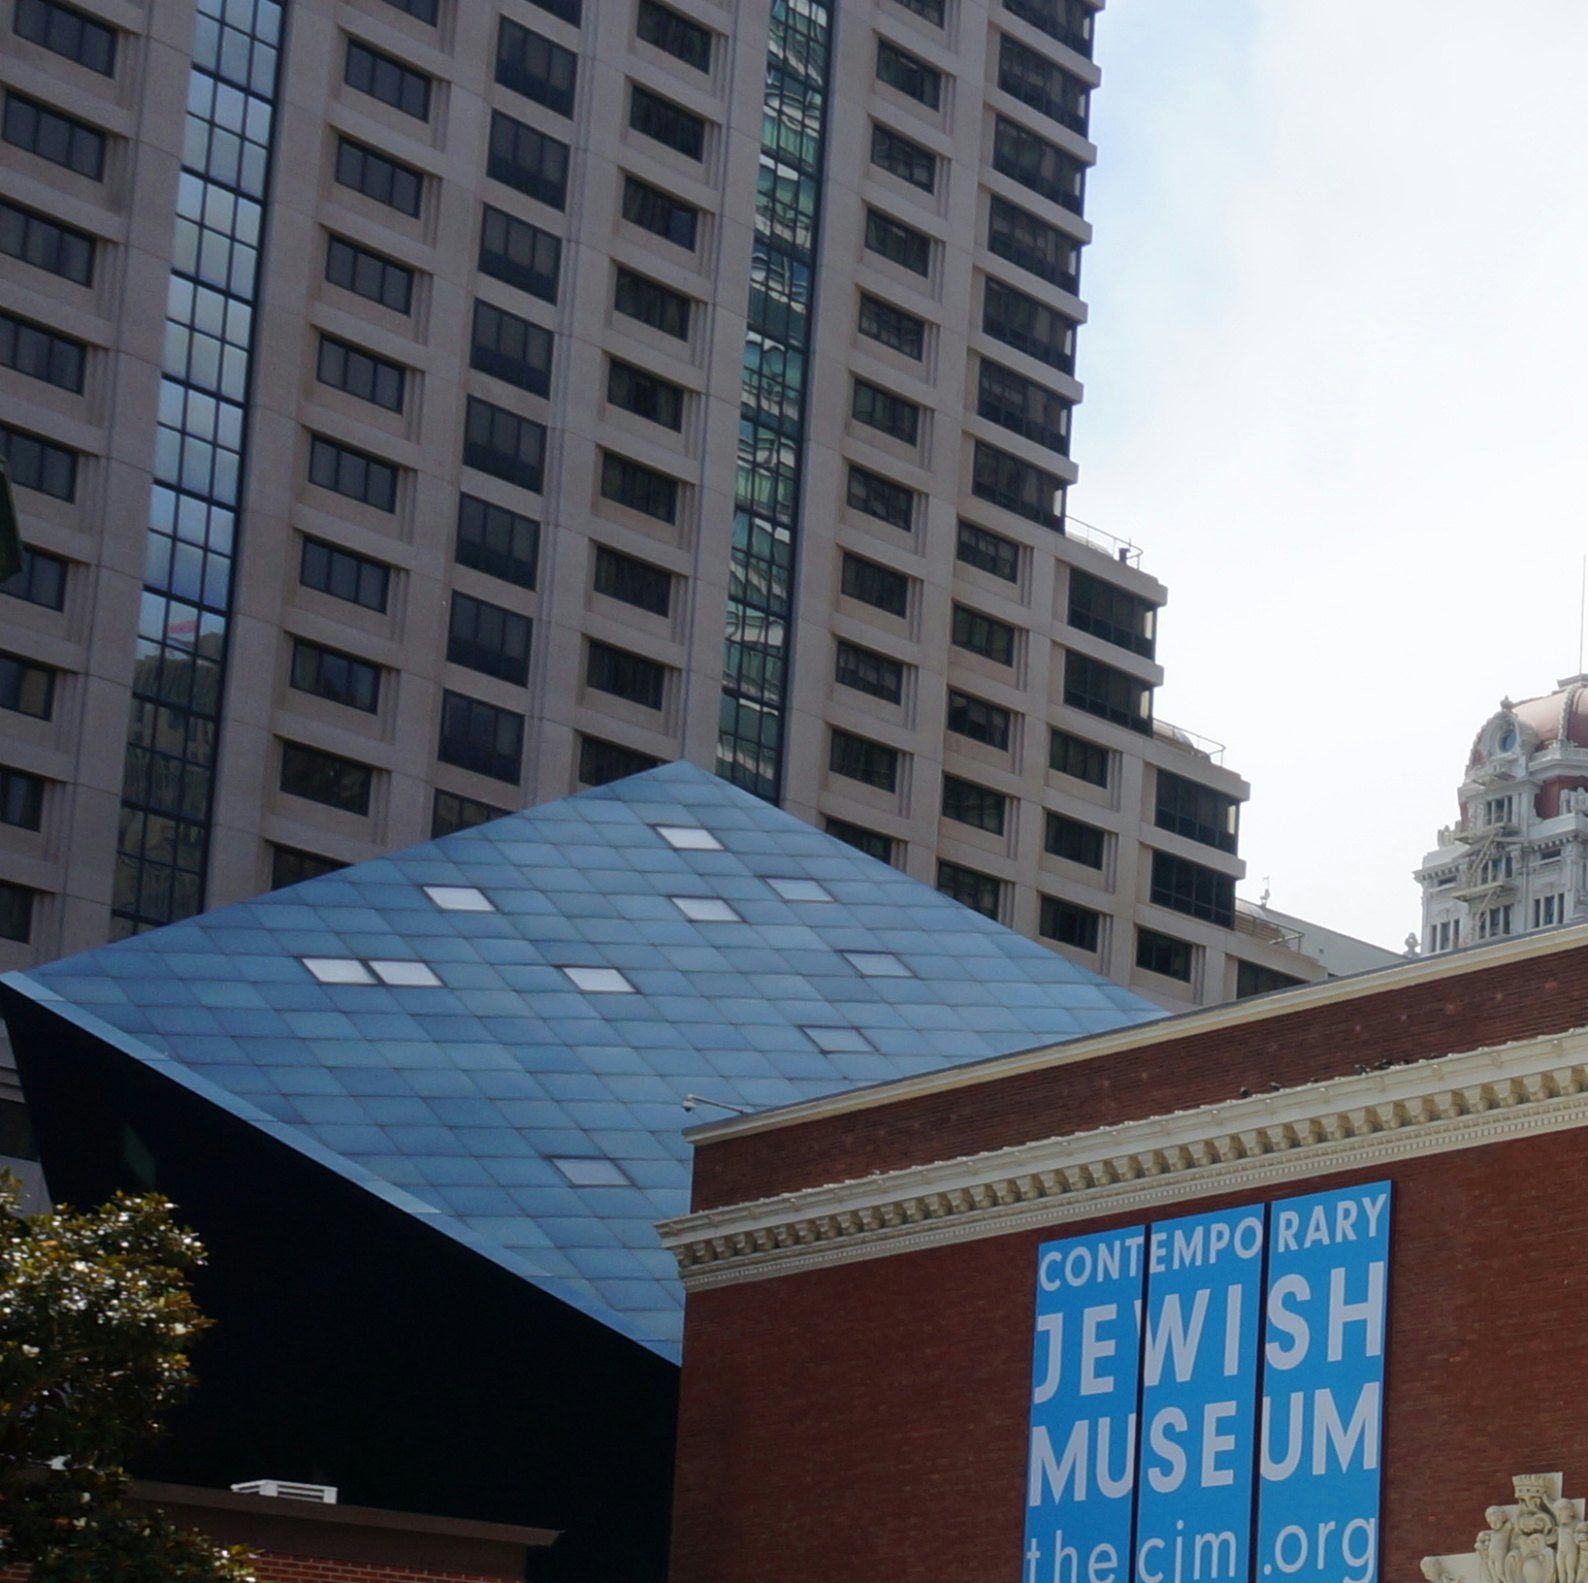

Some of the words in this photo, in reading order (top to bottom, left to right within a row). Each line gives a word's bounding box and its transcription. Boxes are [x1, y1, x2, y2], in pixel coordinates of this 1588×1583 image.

[1039, 1193, 1387, 1292] CONTEMPORARY
[1033, 1260, 1385, 1404] JEWISH
[1028, 1381, 1380, 1507] MUSEUM
